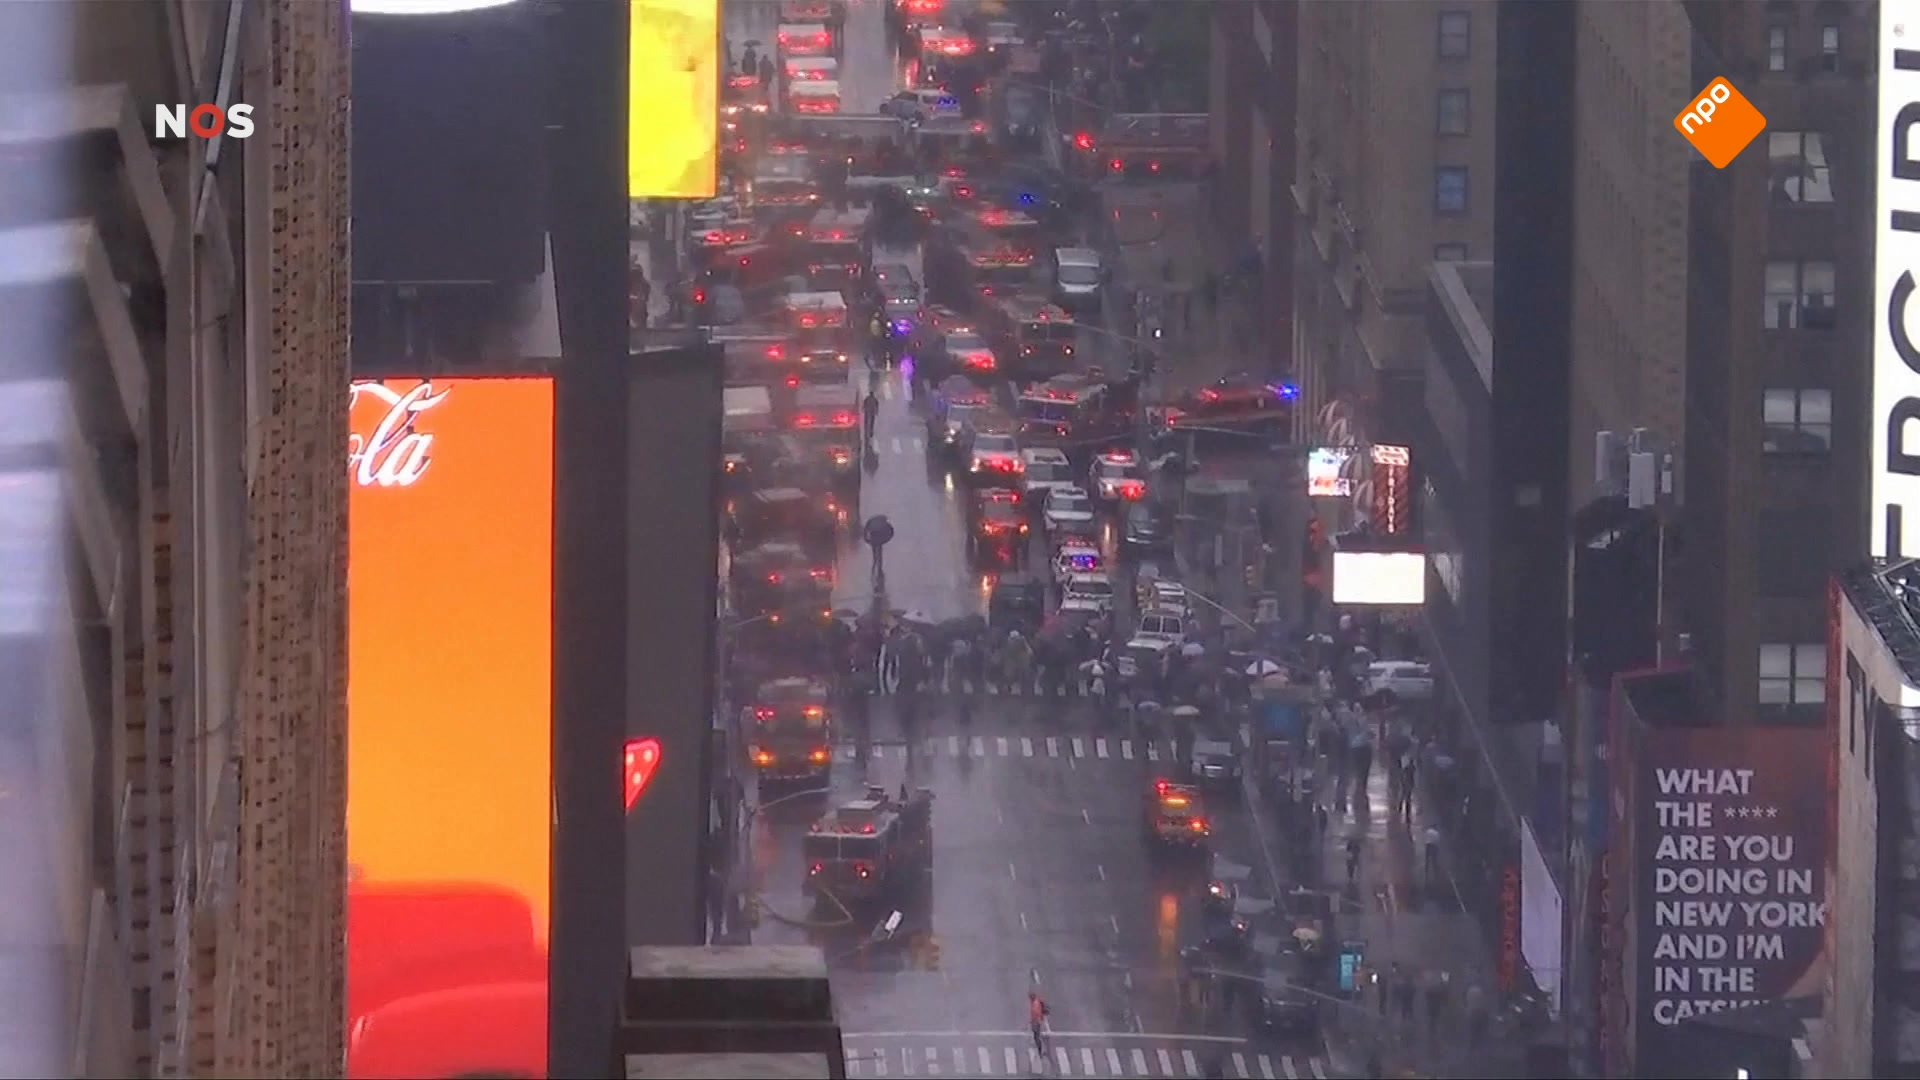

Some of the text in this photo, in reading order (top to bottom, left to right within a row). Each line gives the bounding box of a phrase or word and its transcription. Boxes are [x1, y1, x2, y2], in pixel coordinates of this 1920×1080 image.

[1656, 769, 1754, 795] WHAT
[1656, 802, 1713, 828] THE
[1655, 835, 1793, 862] ARE YOU
[1655, 868, 1812, 895] DOING IN
[1655, 902, 1826, 929] NEW YORK
[1654, 935, 1728, 960] AND
[1655, 967, 1755, 993] IN THE
